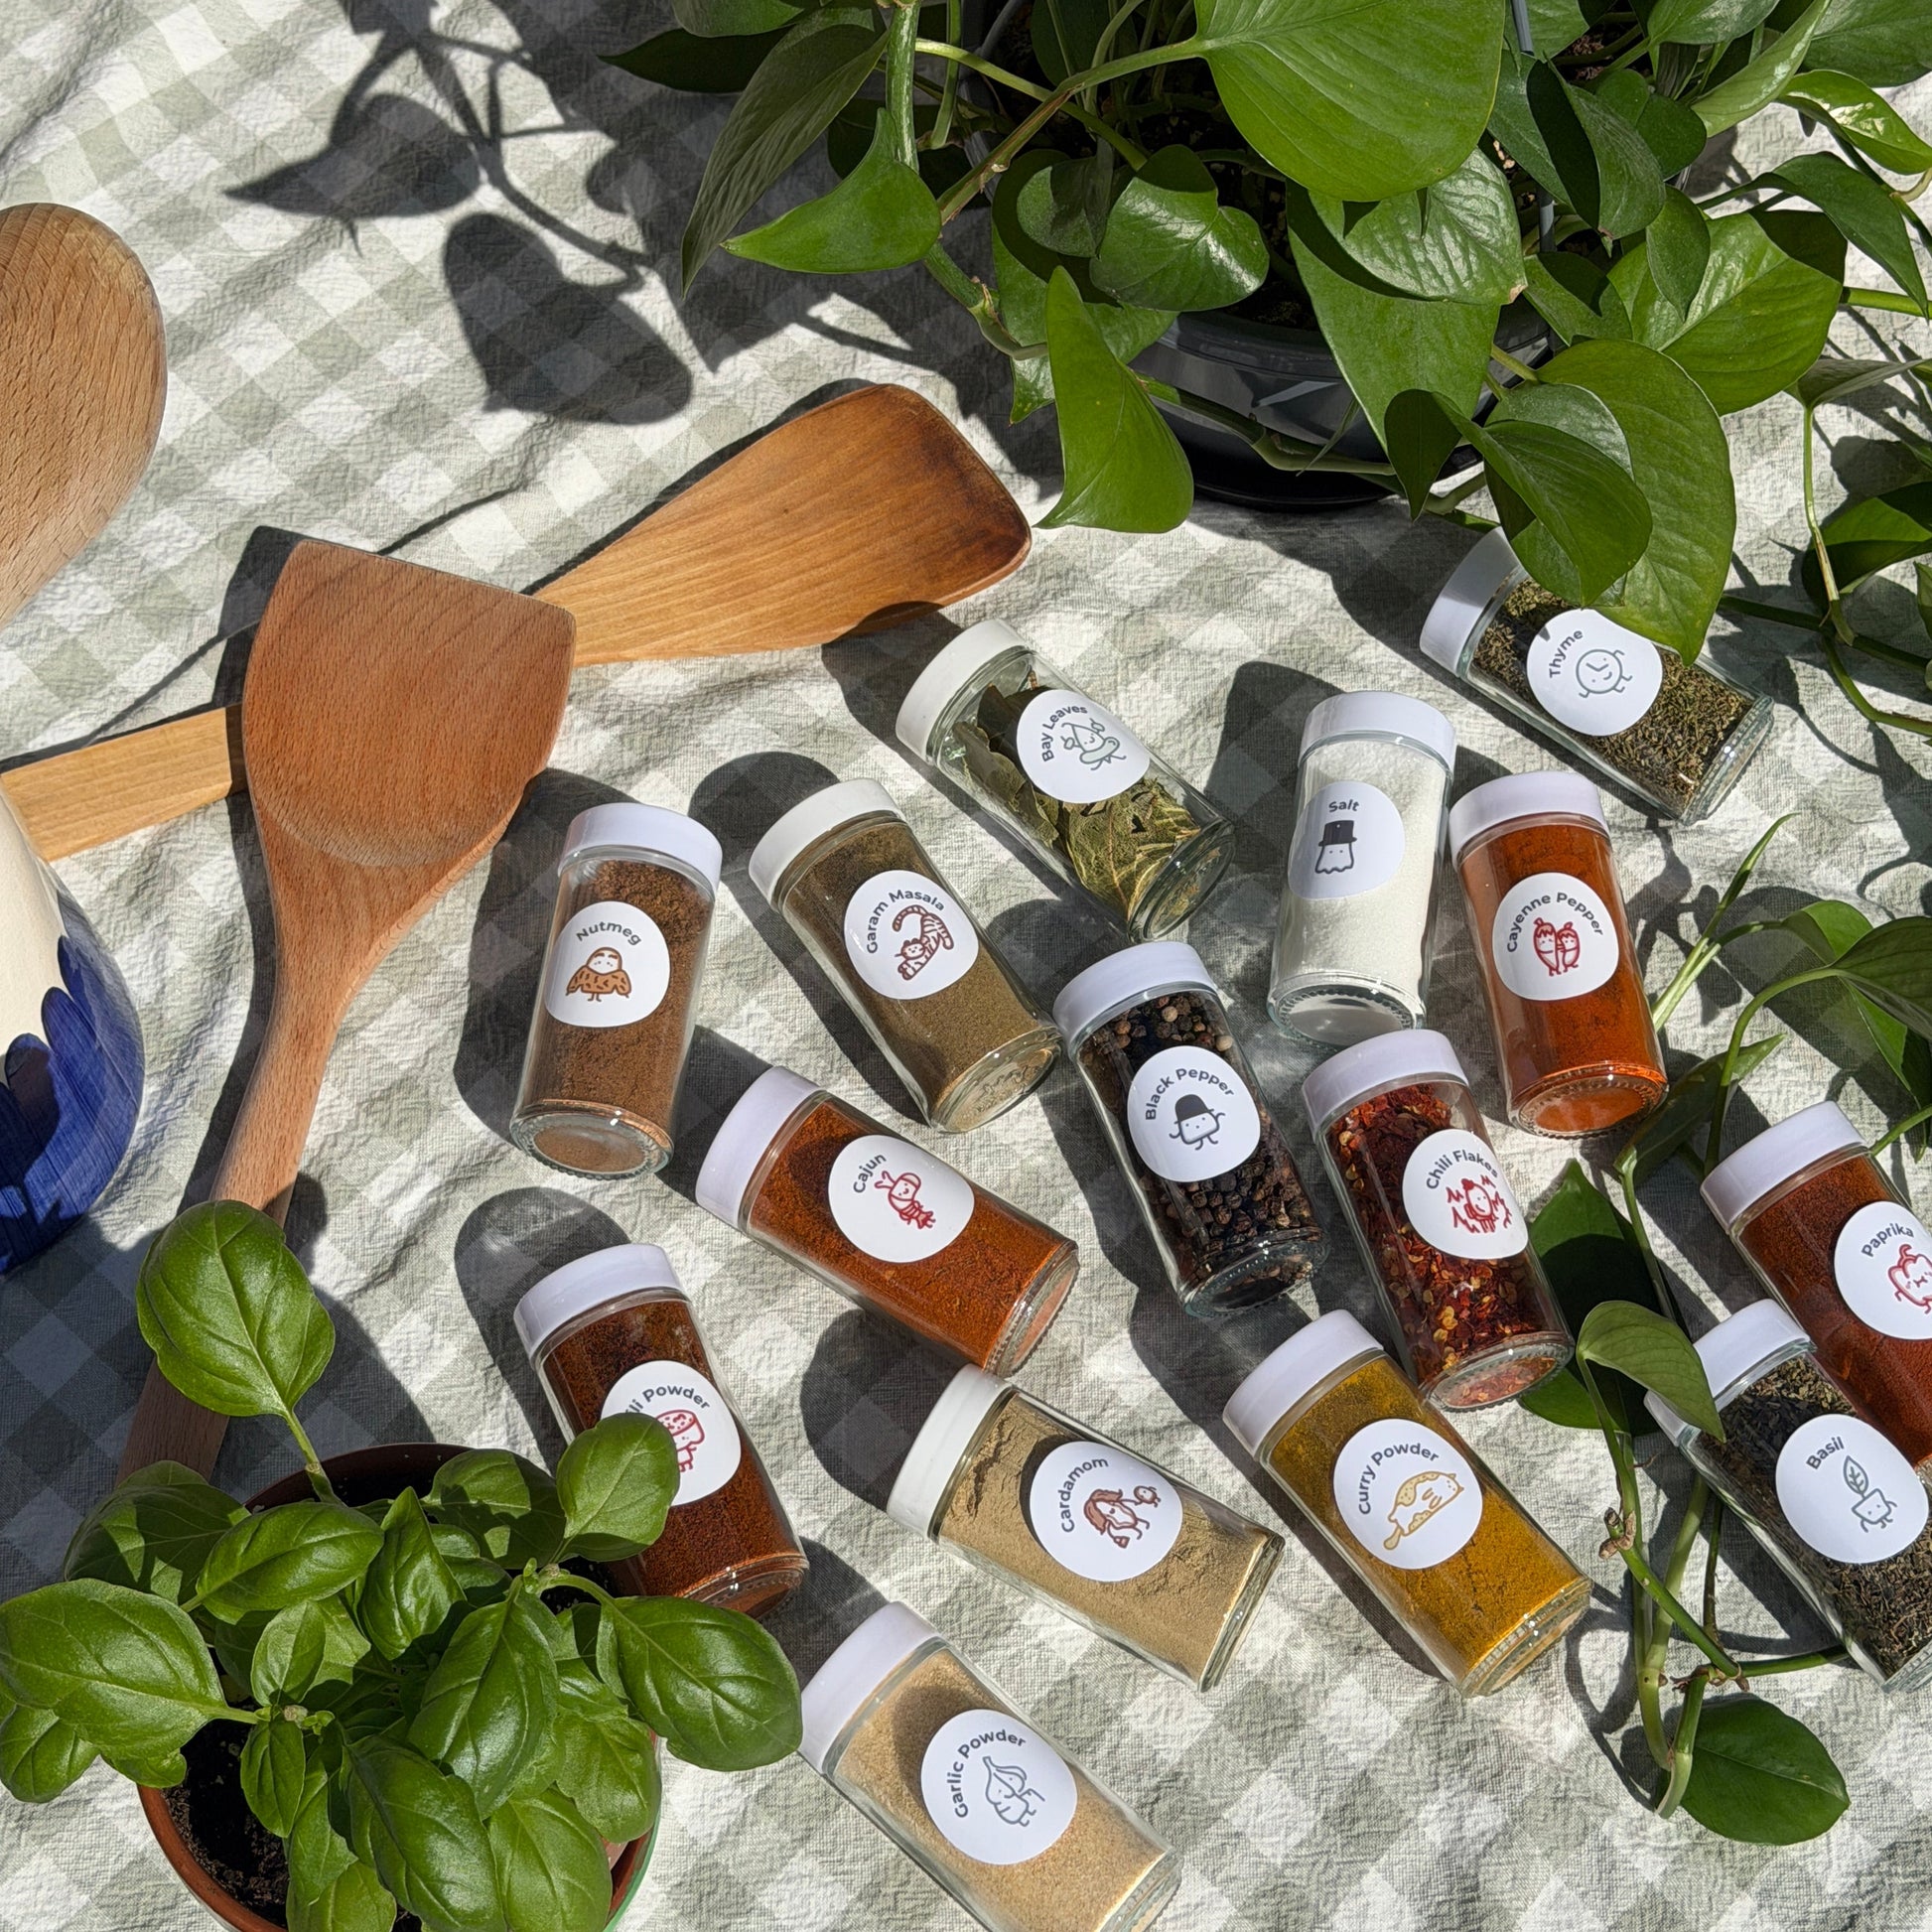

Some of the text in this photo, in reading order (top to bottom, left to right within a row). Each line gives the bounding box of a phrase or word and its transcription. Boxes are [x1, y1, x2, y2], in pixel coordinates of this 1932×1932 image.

[1549, 630, 1584, 678] Thyme
[1041, 706, 1088, 761] Bay Leaves
[1328, 799, 1360, 813] Salt
[576, 921, 641, 946] Nutmeg
[867, 890, 944, 953] Garam Masala
[1507, 892, 1603, 952] Cayenne Pepper
[1145, 1068, 1235, 1120] Black Pepper
[853, 1155, 887, 1193] Cajun
[1426, 1149, 1498, 1189] Chili Flakes
[1862, 1223, 1914, 1258] Paprika
[642, 1385, 710, 1409] Powder
[1806, 1436, 1844, 1469] Basil
[1057, 1458, 1109, 1533] Cardamom
[1358, 1443, 1440, 1515] Curry Powder
[946, 1728, 1027, 1818] Garlic Powder
